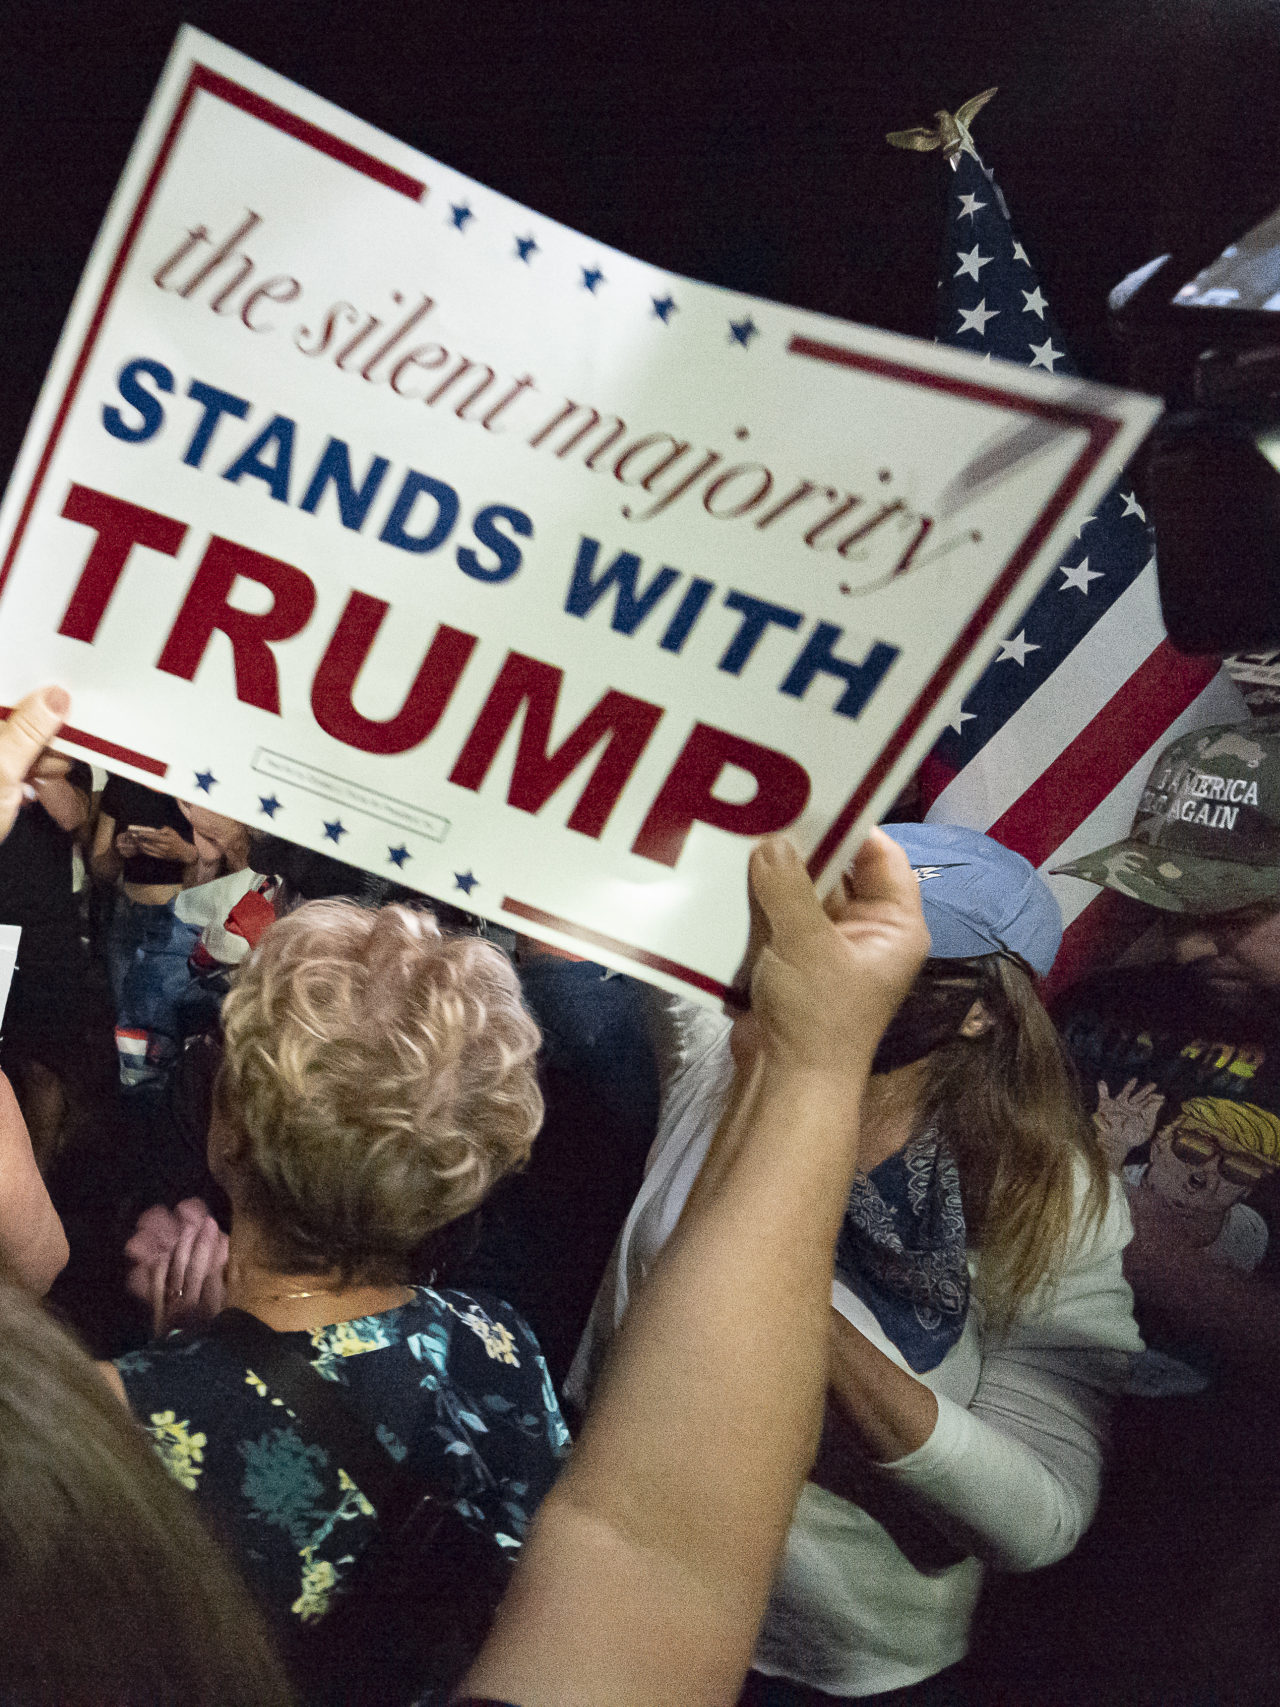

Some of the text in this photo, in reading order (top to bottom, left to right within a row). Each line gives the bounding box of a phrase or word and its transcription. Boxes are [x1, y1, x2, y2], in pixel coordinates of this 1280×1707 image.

[101, 356, 902, 722] STANDS WITH
[152, 207, 983, 597] the silent majority
[56, 481, 812, 869] TRUMP
[1167, 799, 1240, 831] AGAIN
